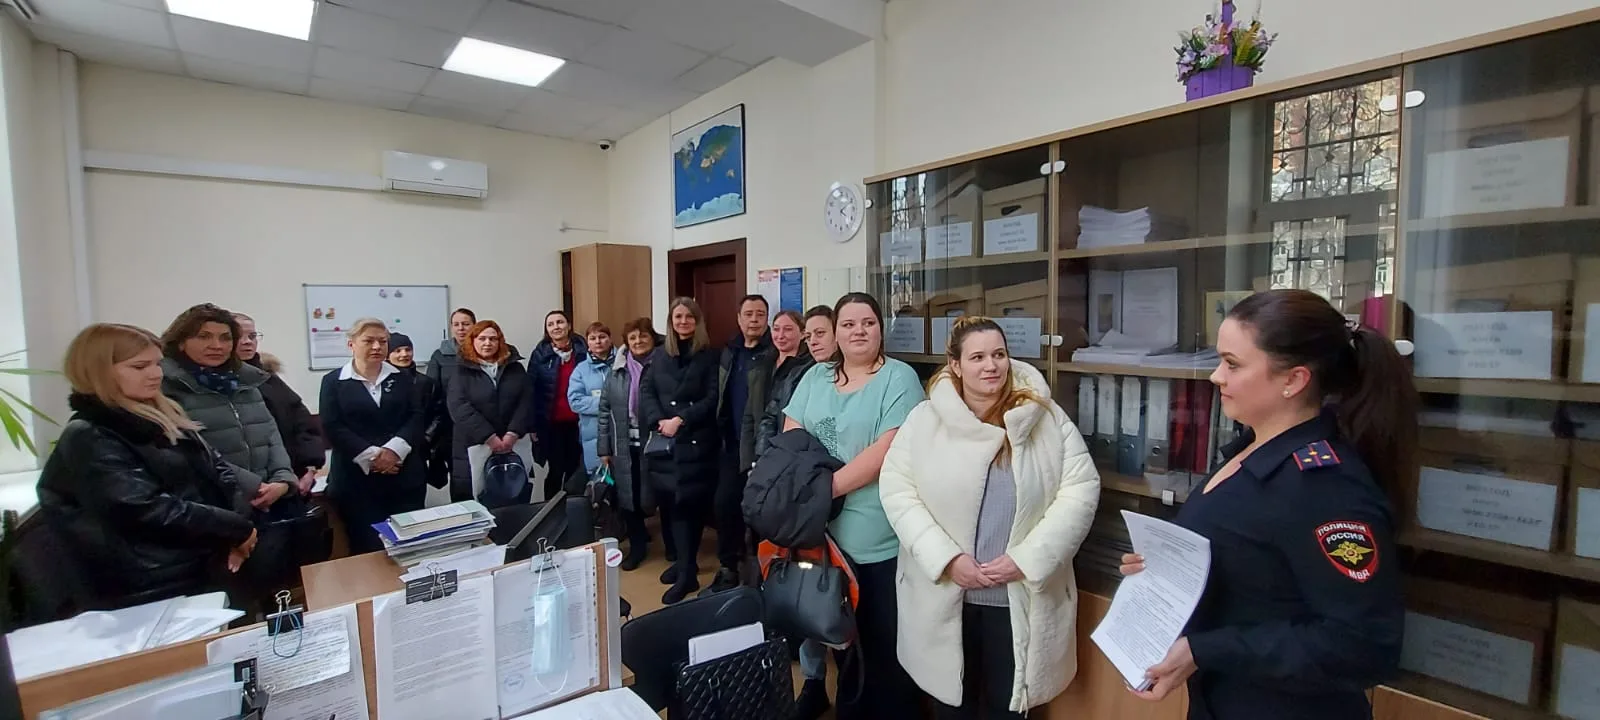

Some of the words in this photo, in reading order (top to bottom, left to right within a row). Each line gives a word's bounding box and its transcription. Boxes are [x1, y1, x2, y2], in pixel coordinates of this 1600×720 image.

[1318, 522, 1366, 536] ПОЛИЦИЯ
[1326, 532, 1366, 544] РОССИЯ
[1348, 569, 1370, 580] МВД
